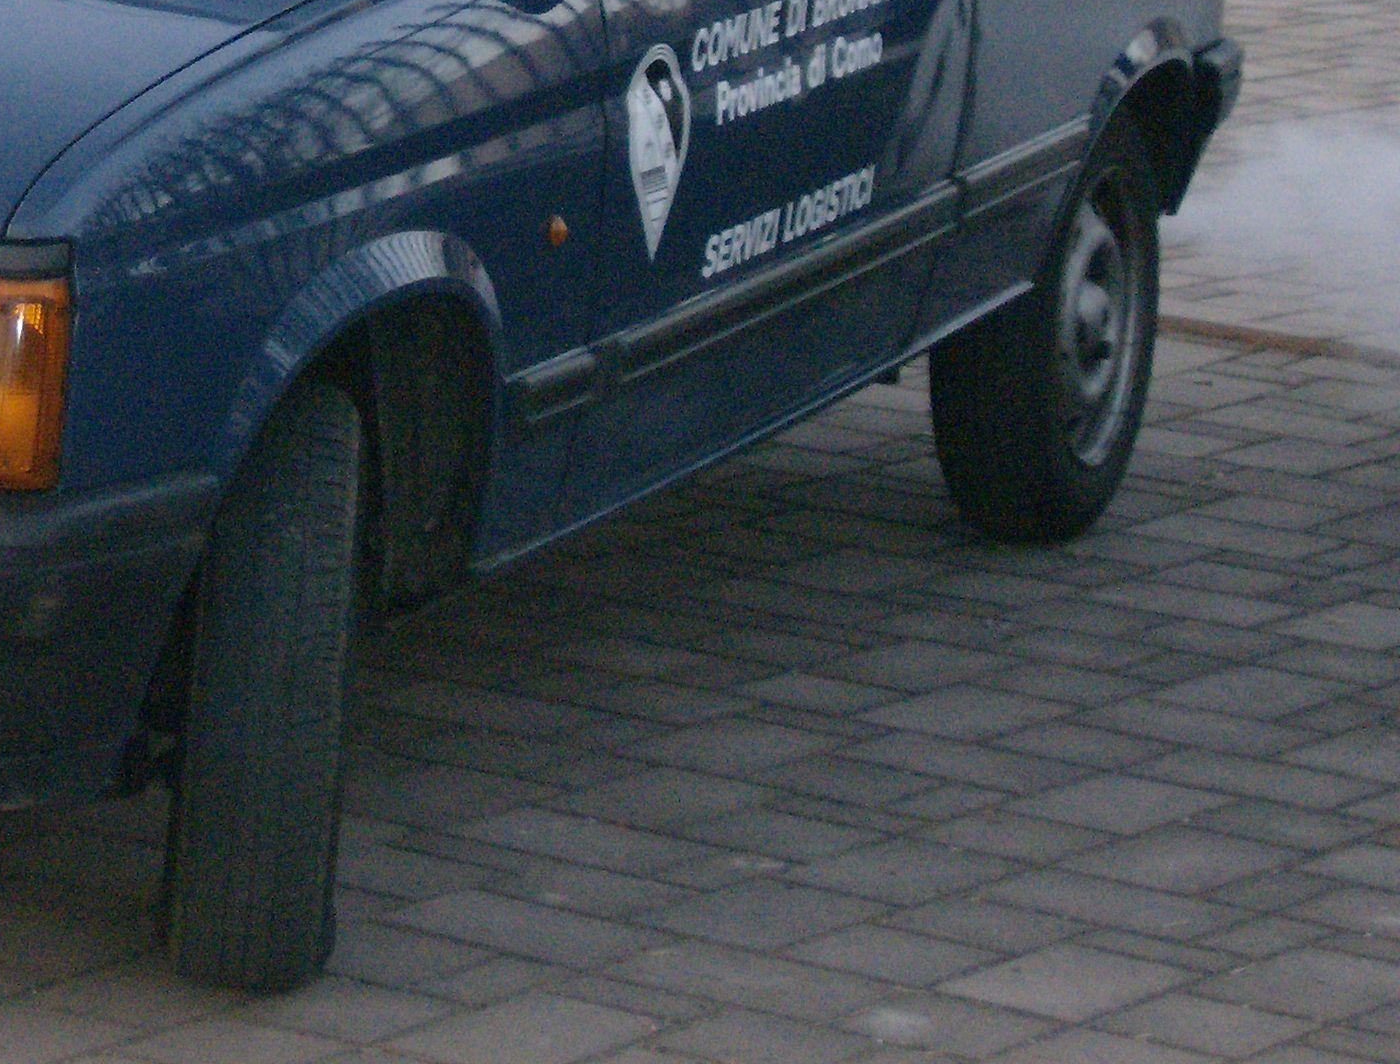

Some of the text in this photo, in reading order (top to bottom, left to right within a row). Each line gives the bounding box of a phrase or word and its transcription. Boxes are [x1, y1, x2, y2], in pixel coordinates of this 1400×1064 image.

[691, 0, 782, 72] COMUNE
[716, 32, 883, 126] Provincia di Como
[701, 163, 876, 279] SERVIZI LOGISTICI
